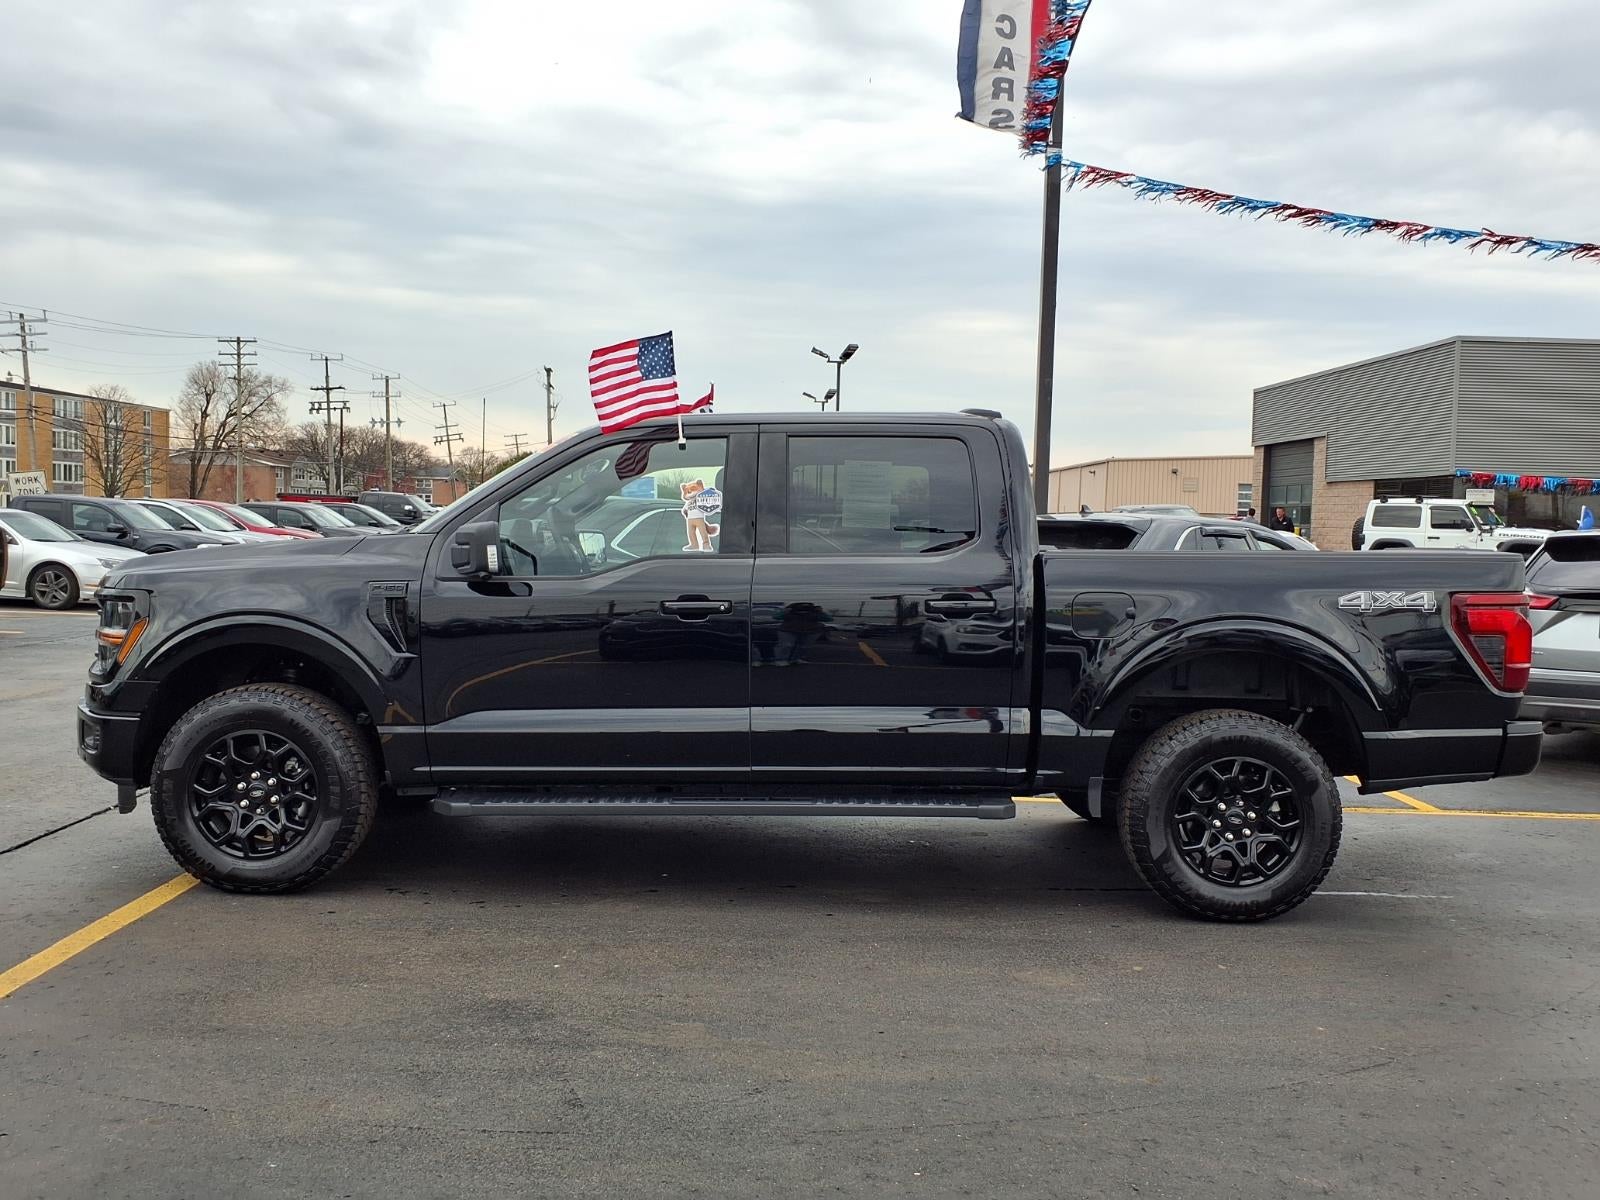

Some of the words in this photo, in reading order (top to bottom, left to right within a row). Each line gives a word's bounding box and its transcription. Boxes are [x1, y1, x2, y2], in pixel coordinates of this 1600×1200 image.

[15, 475, 39, 485] WORK
[17, 487, 41, 496] ZONE
[1498, 532, 1545, 540] RUBICON
[371, 584, 405, 592] F-150
